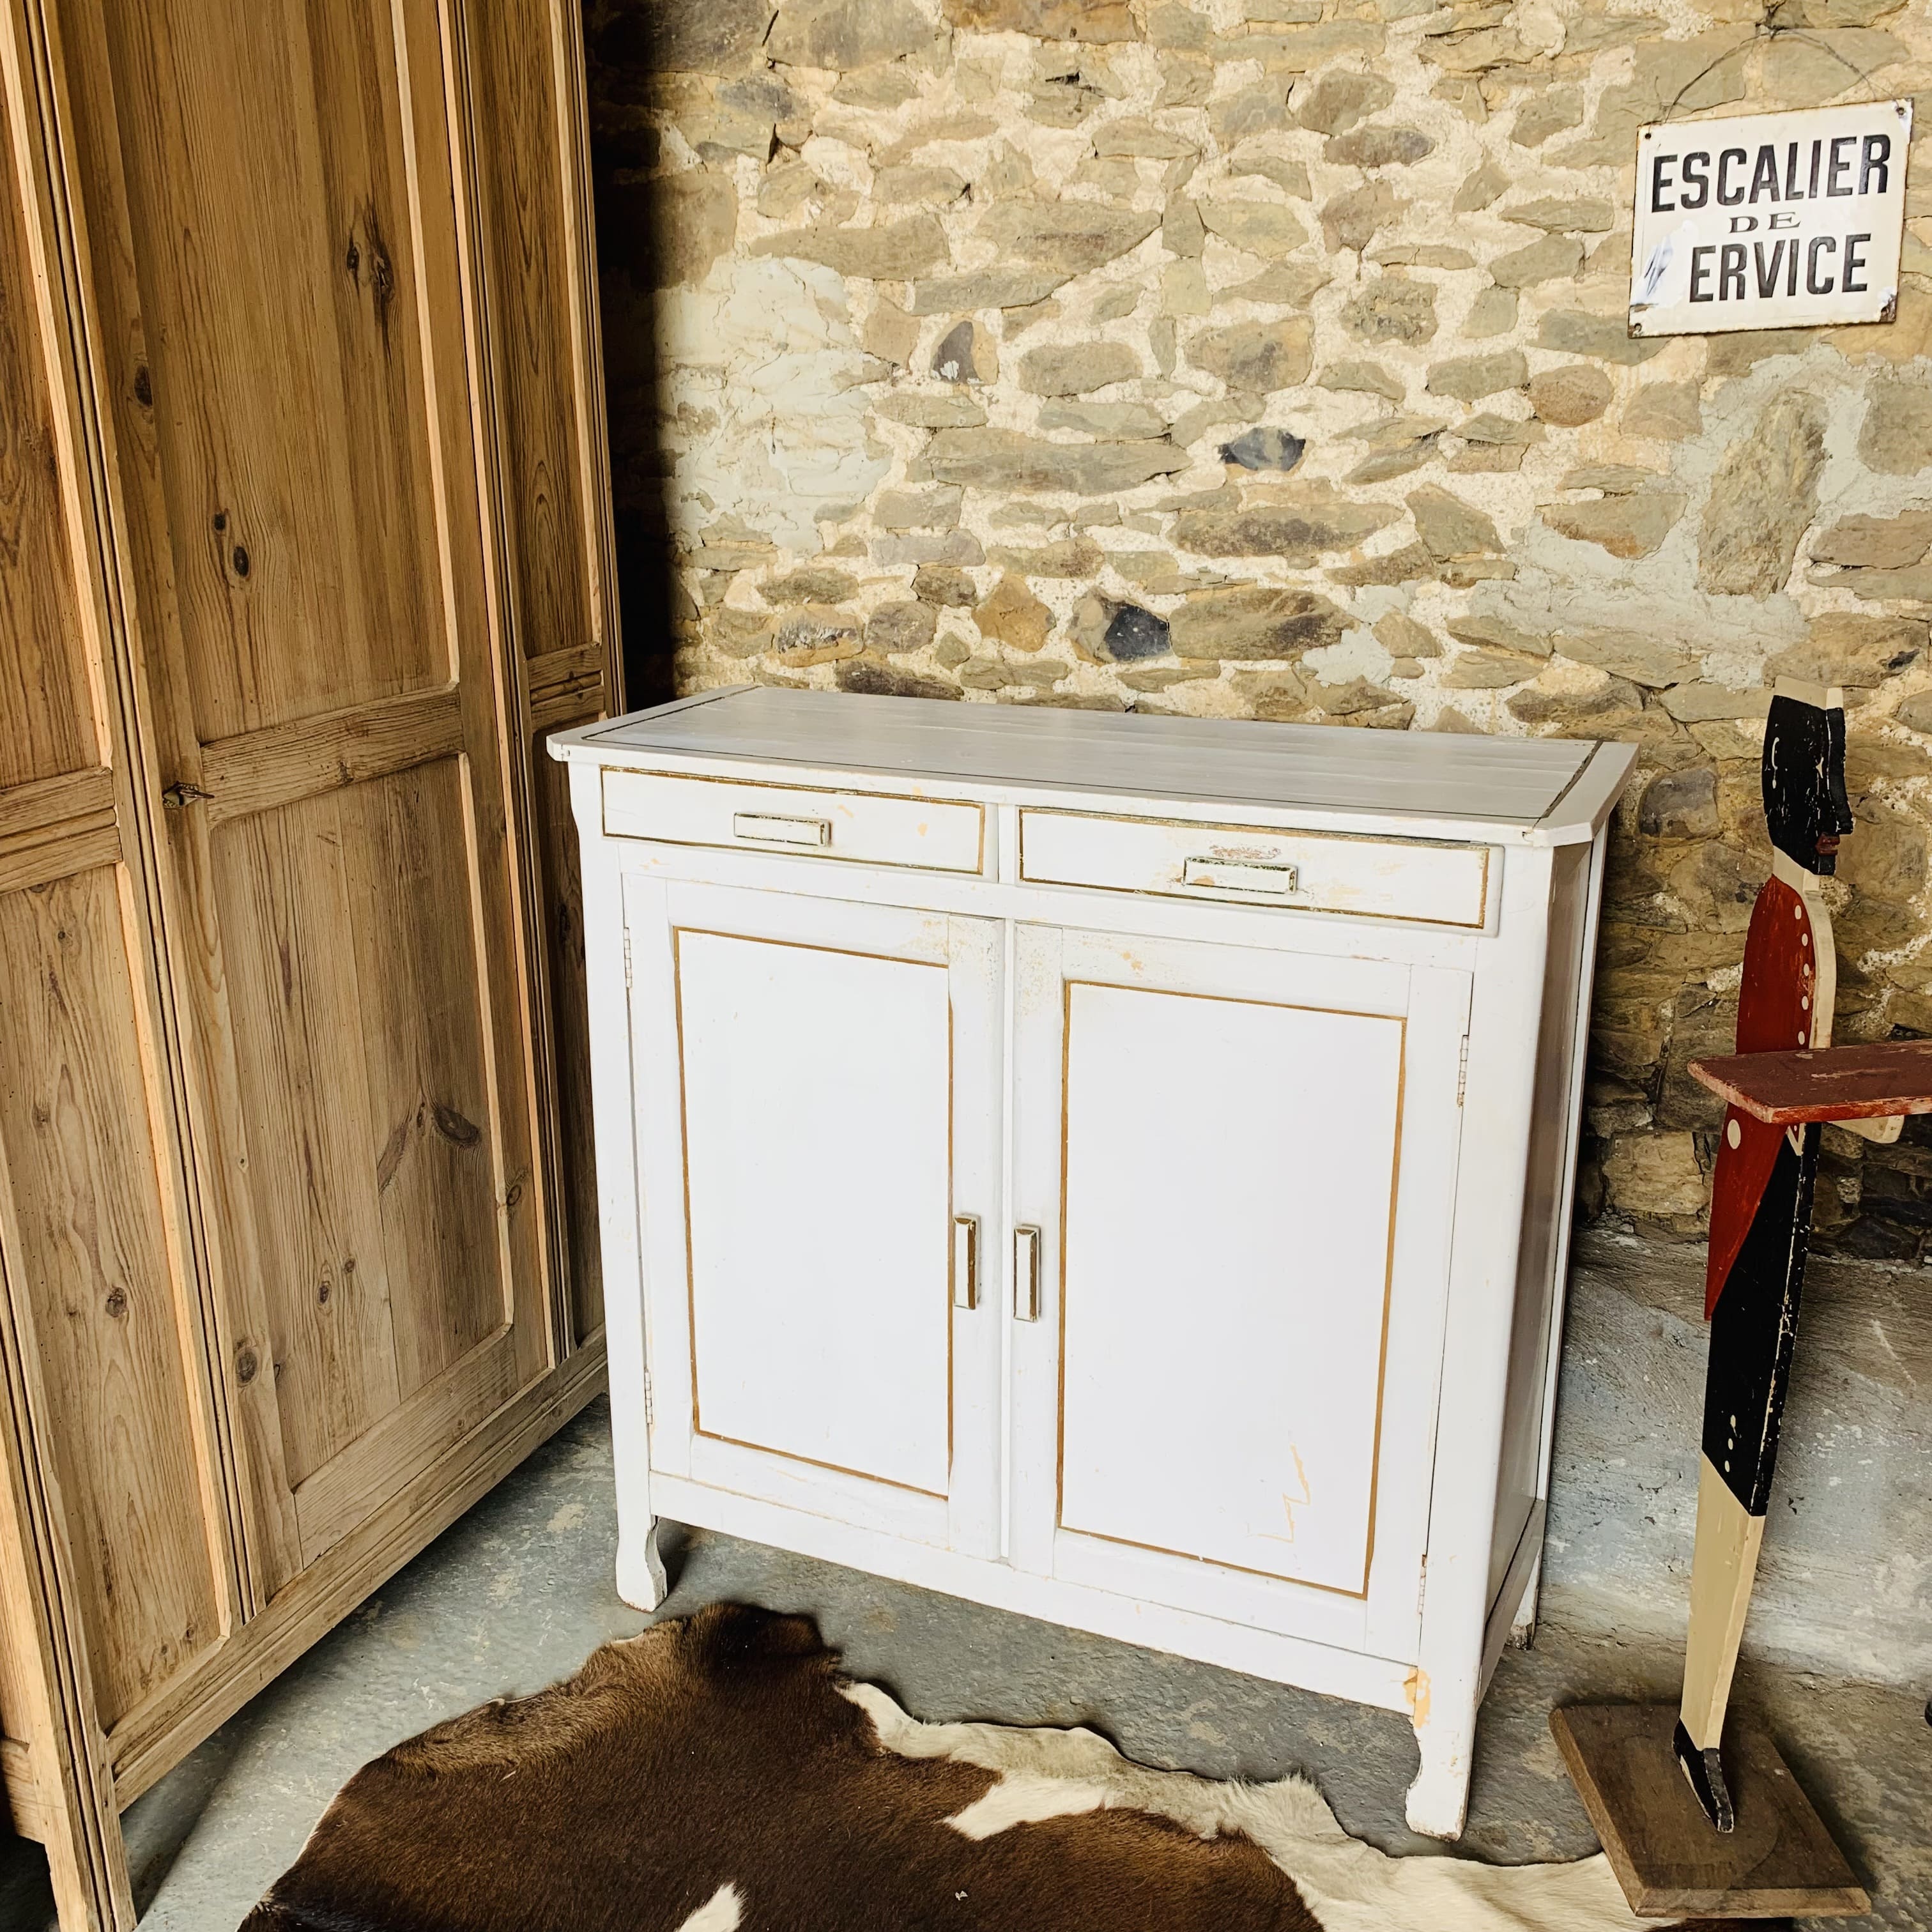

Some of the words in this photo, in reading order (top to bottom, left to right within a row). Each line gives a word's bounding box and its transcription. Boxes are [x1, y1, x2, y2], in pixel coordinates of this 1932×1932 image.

[1652, 134, 1890, 213] ESCALIER
[1729, 211, 1801, 234] DE
[1689, 233, 1871, 303] ERVICE
